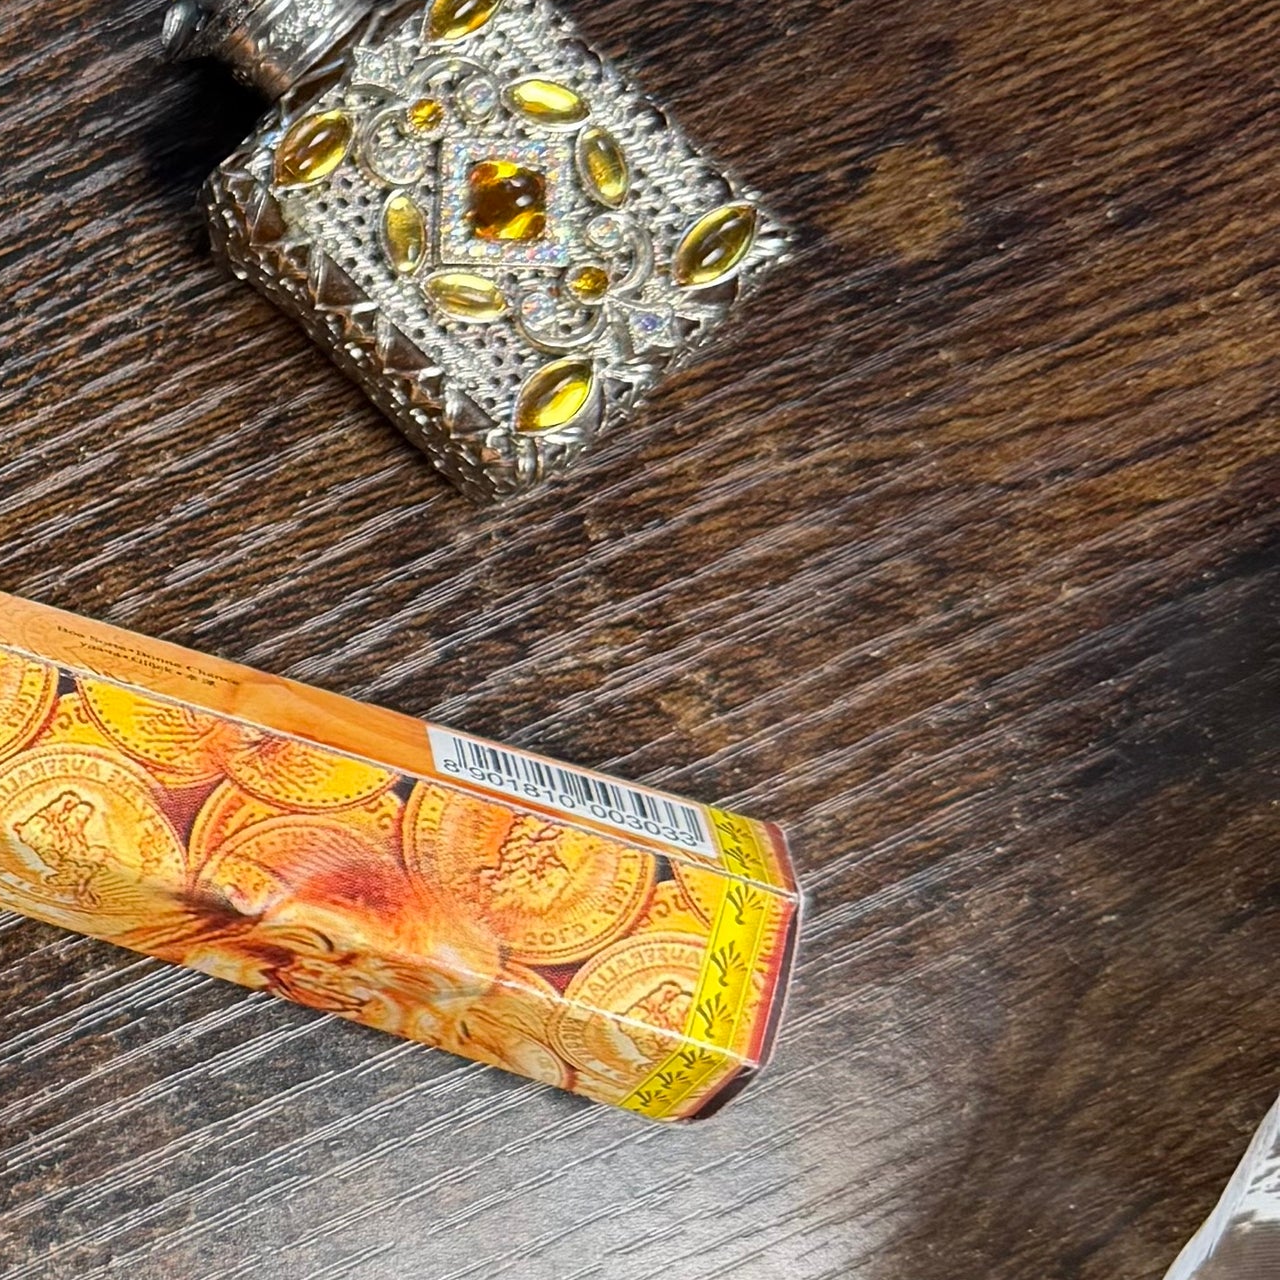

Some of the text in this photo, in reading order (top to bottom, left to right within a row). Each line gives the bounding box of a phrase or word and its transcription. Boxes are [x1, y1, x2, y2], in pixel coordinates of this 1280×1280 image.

[442, 758, 698, 848] 8 901810 003033
